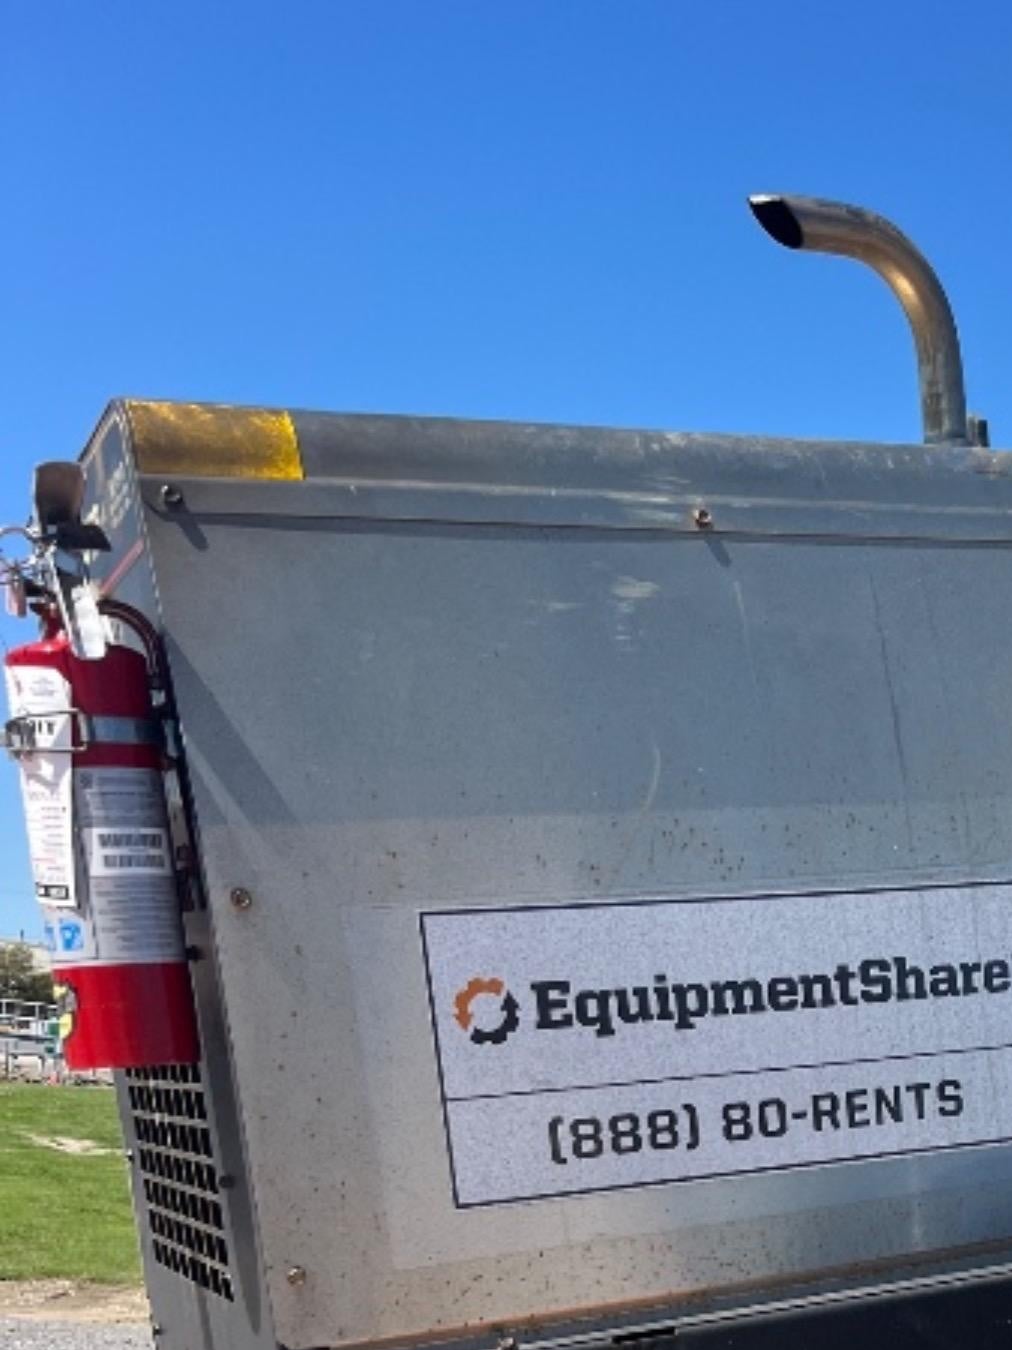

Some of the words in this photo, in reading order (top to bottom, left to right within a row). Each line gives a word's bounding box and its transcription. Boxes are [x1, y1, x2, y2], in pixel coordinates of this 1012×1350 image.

[530, 956, 1012, 1037] EquipmentShare
[547, 1103, 702, 1165] (888)
[720, 1078, 965, 1143] 80-RENTS
